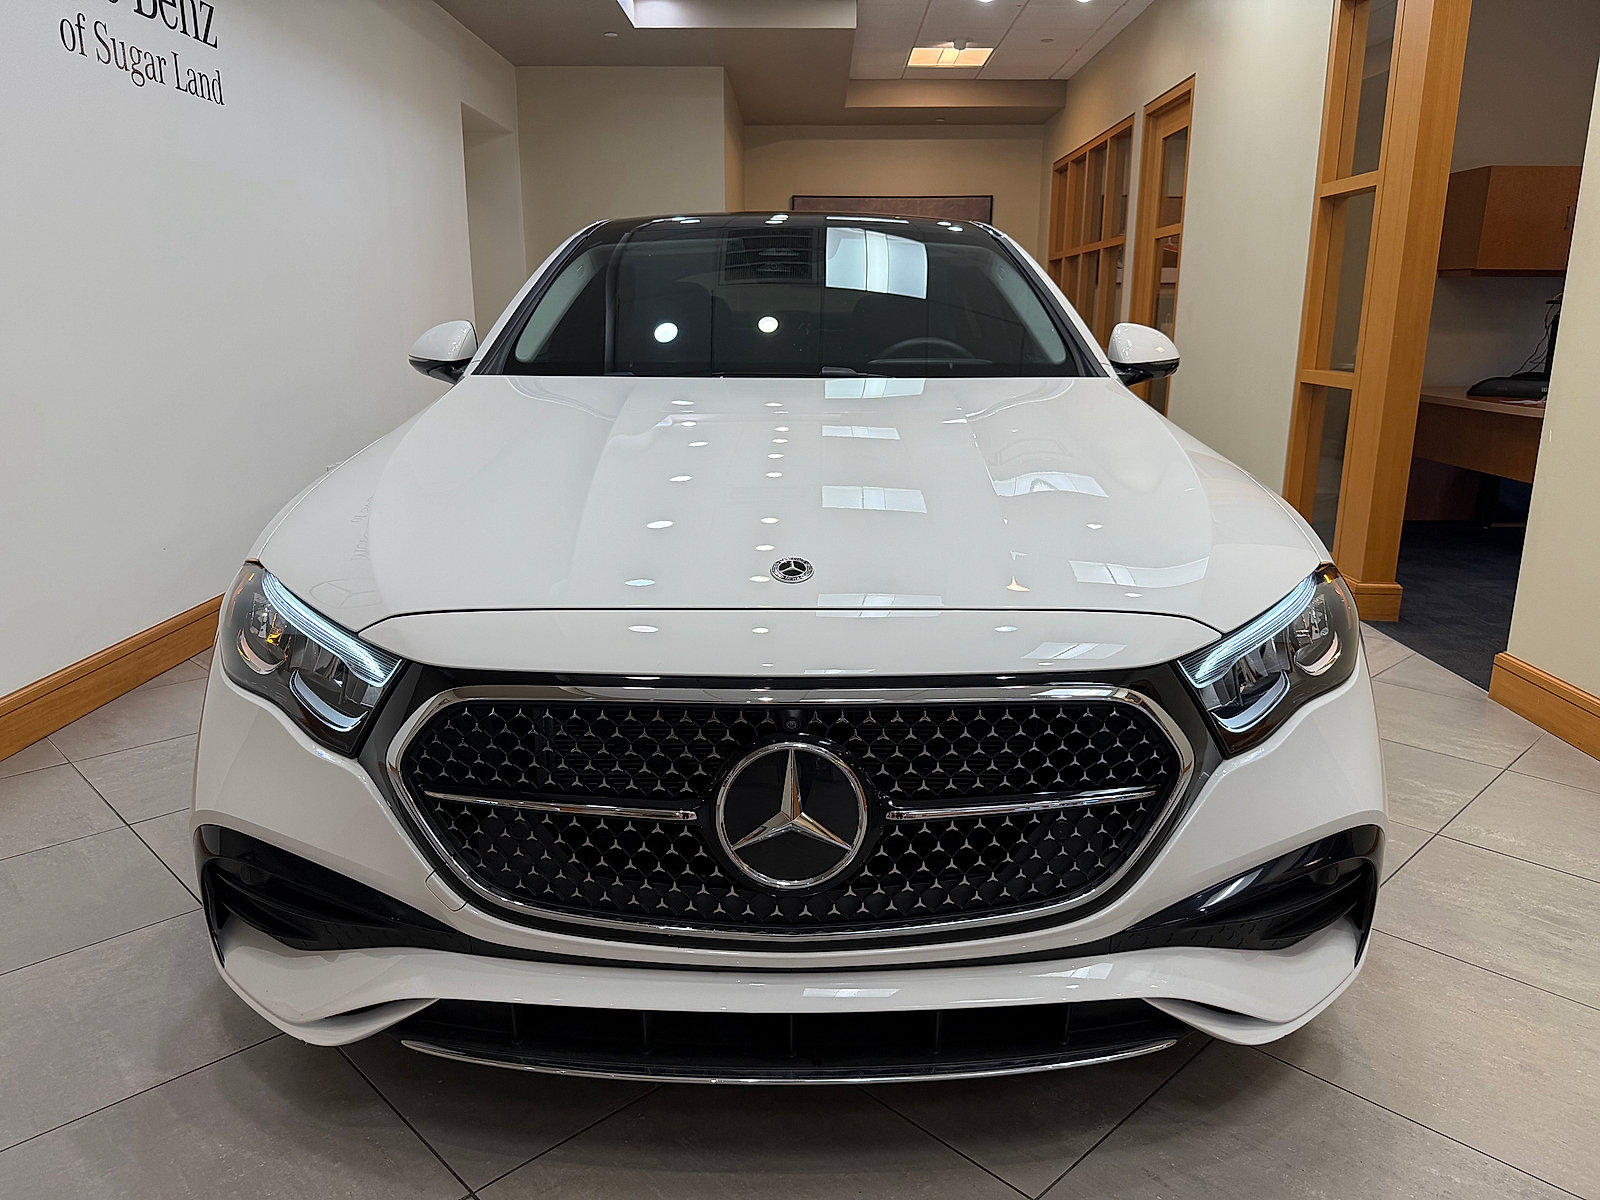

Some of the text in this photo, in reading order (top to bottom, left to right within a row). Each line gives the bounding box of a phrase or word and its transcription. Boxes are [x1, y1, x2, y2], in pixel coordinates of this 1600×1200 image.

[59, 12, 225, 106] of Sugar Land
